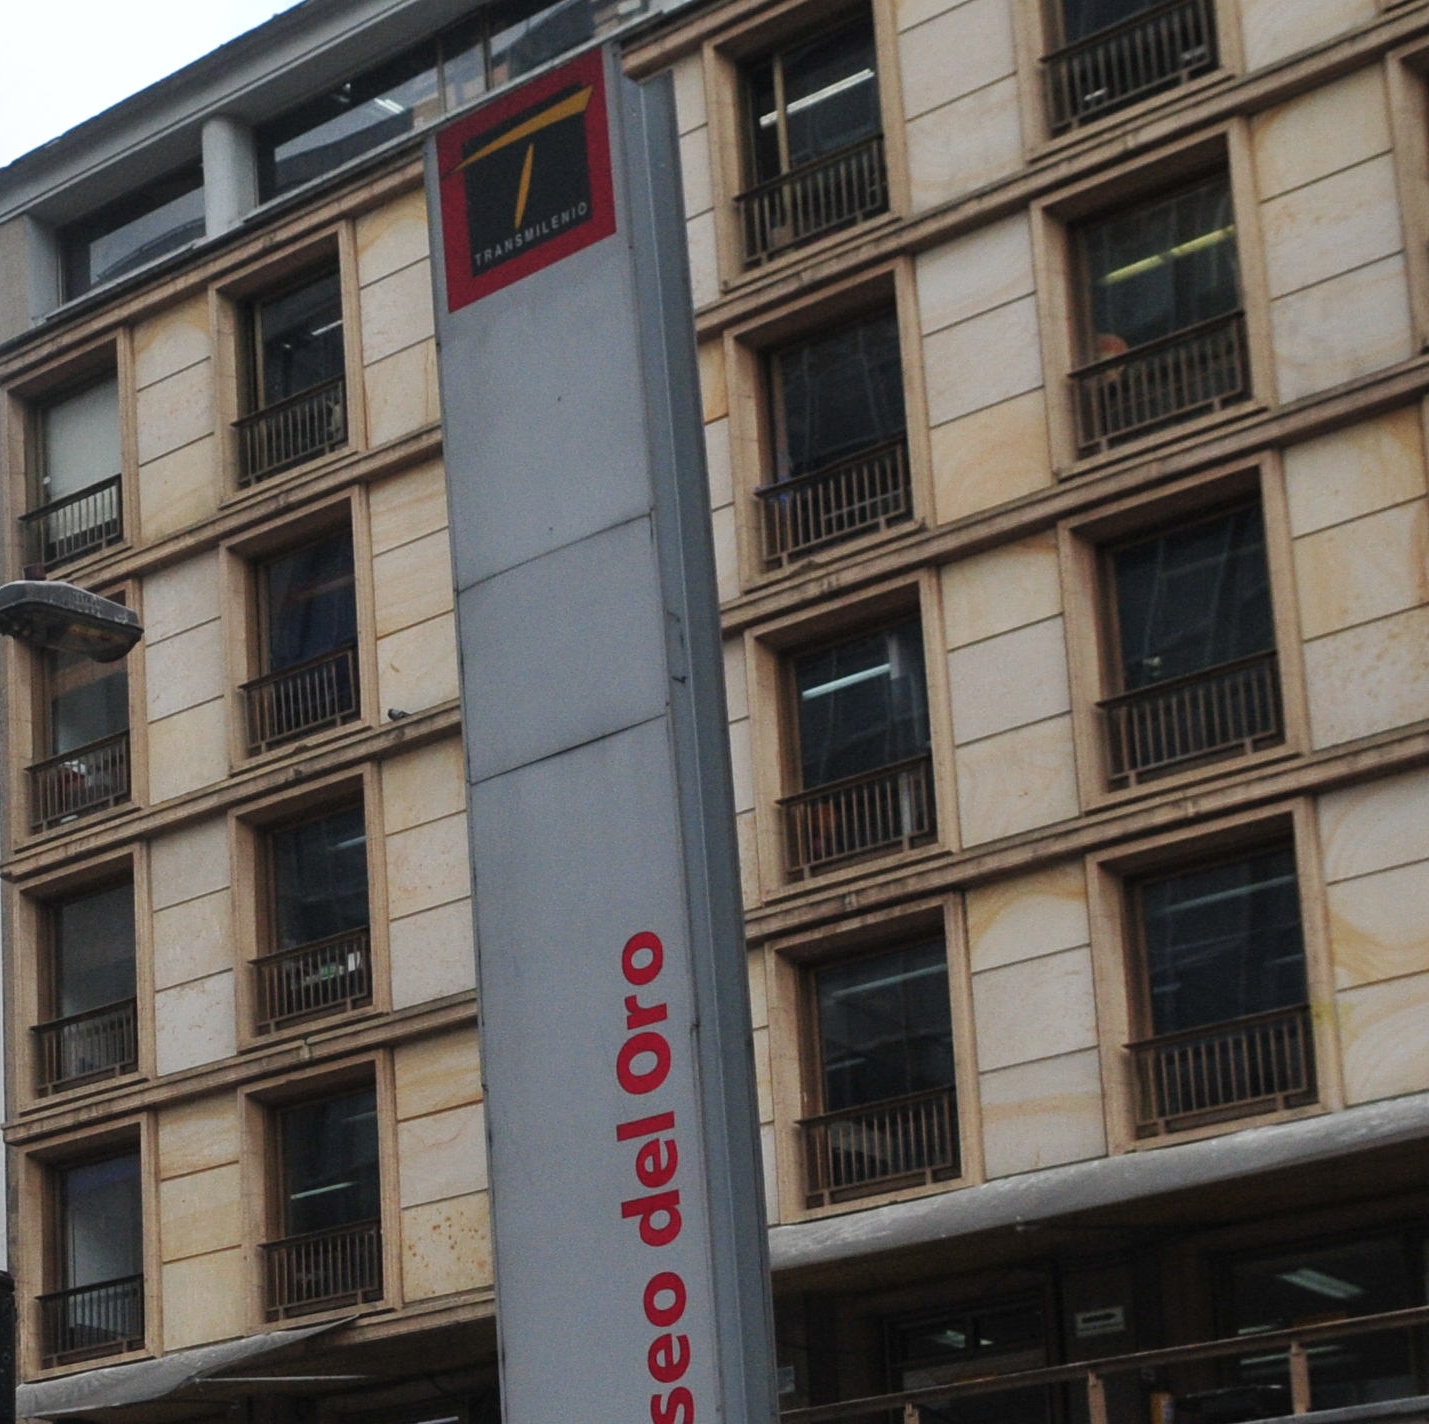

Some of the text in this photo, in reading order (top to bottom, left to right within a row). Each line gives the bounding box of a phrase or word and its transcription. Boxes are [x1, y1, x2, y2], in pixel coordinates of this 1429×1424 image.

[473, 201, 589, 267] TRANSMILENIO
[617, 931, 671, 1094] Oro
[618, 1112, 681, 1247] del
